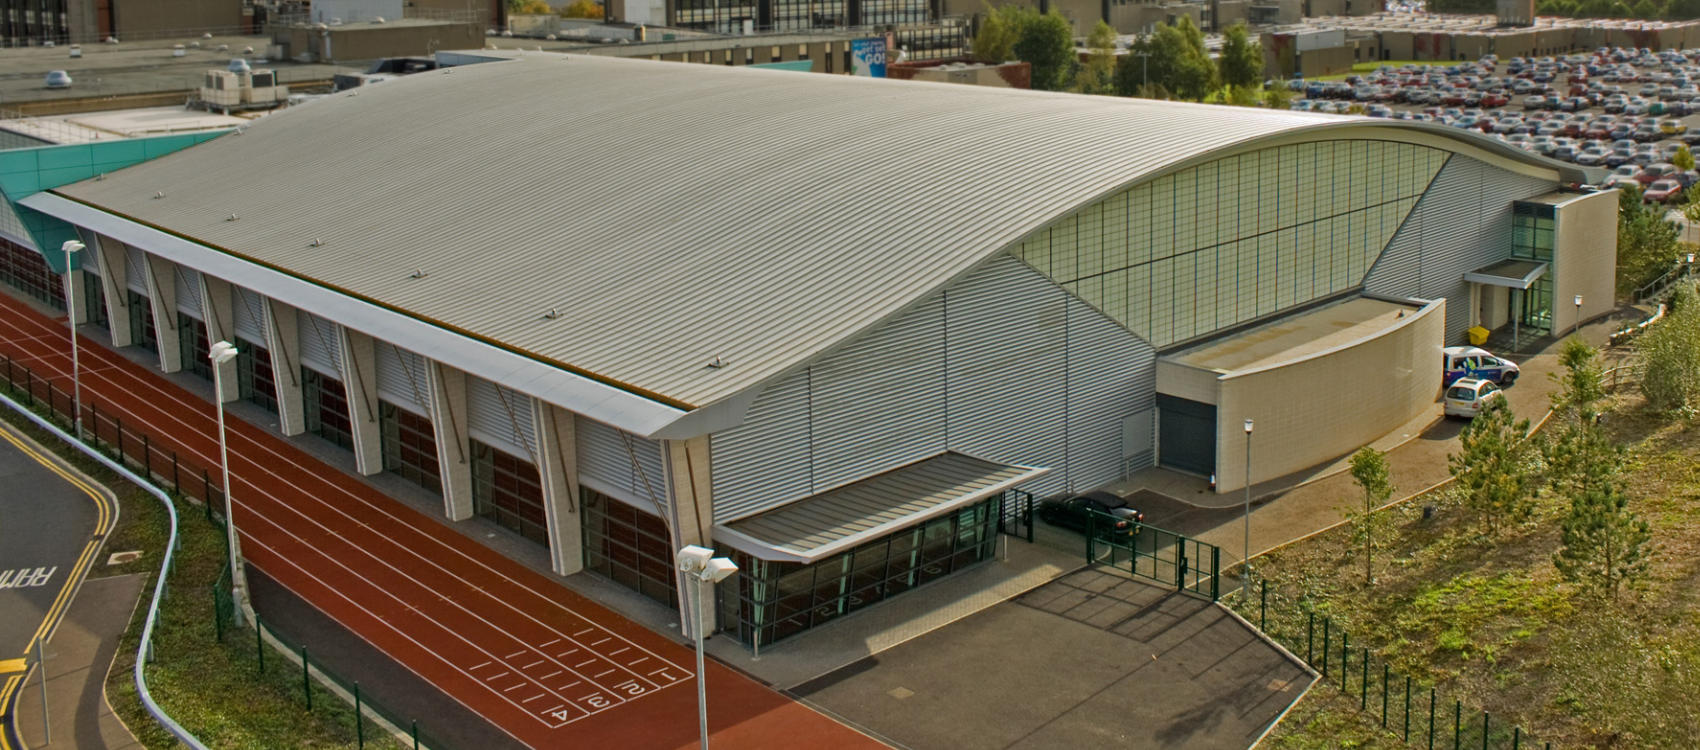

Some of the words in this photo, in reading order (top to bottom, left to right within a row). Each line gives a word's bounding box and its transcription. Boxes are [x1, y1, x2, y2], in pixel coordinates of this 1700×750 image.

[865, 53, 886, 65] GO!
[0, 566, 58, 589] RAM
[661, 672, 676, 681] 1
[621, 681, 645, 695] 2
[587, 695, 610, 708] 3
[551, 709, 568, 721] 4
